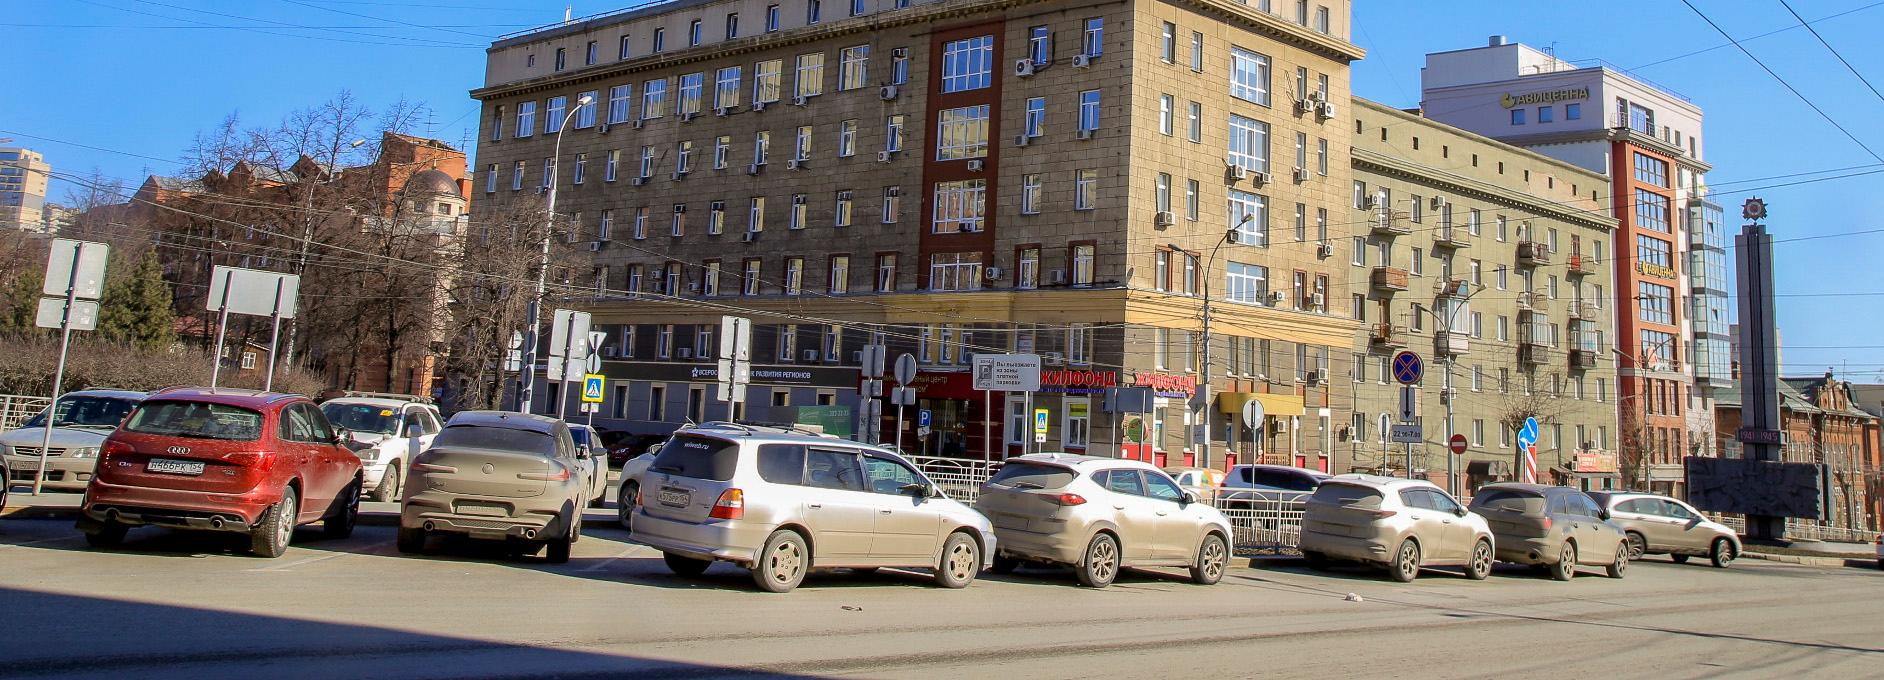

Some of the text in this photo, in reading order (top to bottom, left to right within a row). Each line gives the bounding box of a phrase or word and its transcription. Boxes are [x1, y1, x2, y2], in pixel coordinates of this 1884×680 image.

[1517, 87, 1589, 105] АВИЦЕННА
[756, 370, 782, 378] РАЗВИТИЯ
[782, 371, 811, 379] РЕГИОНОВ
[1041, 371, 1116, 388] ЖИЛФОНД
[1135, 372, 1196, 394] ЖИЛФОНД
[1740, 431, 1777, 440] 1941 1945
